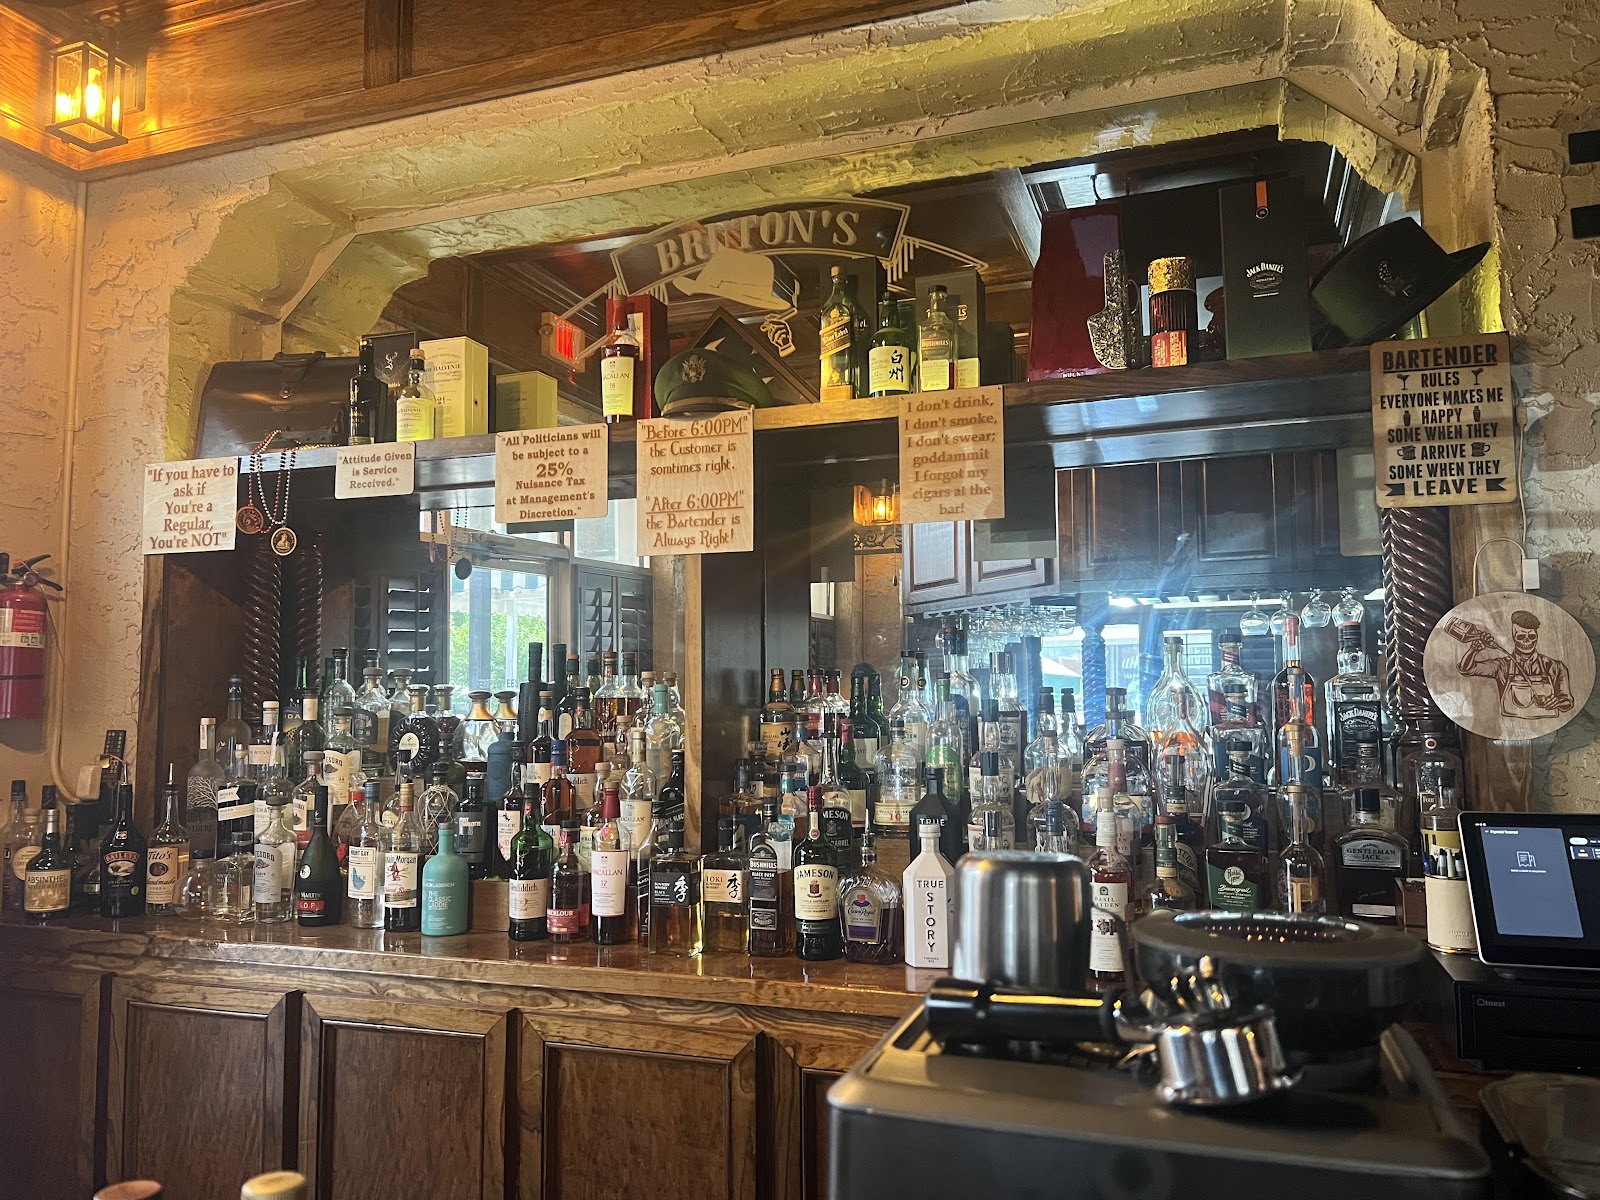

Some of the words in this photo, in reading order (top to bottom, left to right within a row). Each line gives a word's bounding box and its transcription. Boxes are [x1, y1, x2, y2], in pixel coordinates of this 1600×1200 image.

[1246, 265, 1261, 277] JACK
[1261, 262, 1284, 273] DANIEL'S
[1383, 343, 1498, 370] BARTENDER
[1421, 371, 1460, 388] RULES
[907, 402, 912, 413] I
[916, 399, 950, 412] don't
[953, 394, 994, 410] drink,
[1380, 392, 1440, 410] EVERYONE
[1442, 388, 1483, 406] MAKES
[1487, 387, 1504, 403] ME
[905, 420, 910, 431] I
[913, 416, 947, 430] don't
[950, 412, 998, 427] smoke,
[1421, 408, 1462, 425] HAPPY
[642, 424, 686, 440] "Before
[691, 415, 748, 437] 6:00PM"
[1387, 427, 1421, 443] SOME
[1425, 424, 1463, 441] WHEN
[1466, 422, 1498, 438] THEY
[502, 436, 519, 446] "All
[523, 432, 578, 444] Politicians
[582, 429, 601, 439] will
[907, 436, 913, 448] I
[916, 434, 950, 447] don't
[953, 432, 996, 443] swear;
[512, 451, 524, 460] be
[527, 448, 565, 460] subject
[569, 447, 579, 456] to
[583, 447, 589, 455] a
[650, 443, 666, 457] the
[670, 440, 722, 455] Customer
[727, 441, 736, 451] is
[1421, 443, 1466, 460] ARRIVE
[339, 453, 381, 465] "Attitude
[384, 452, 412, 461] Given
[651, 462, 701, 475] somtimes
[705, 456, 735, 475] right.
[913, 449, 990, 468] goddammit
[148, 467, 163, 482] "If
[166, 470, 188, 486] you
[192, 466, 219, 479] have
[223, 465, 234, 476] to
[352, 468, 360, 476] is
[363, 465, 398, 476] Service
[536, 461, 573, 478] 25%
[915, 471, 921, 482] I
[923, 468, 965, 484] forgot
[967, 468, 989, 481] my
[1389, 464, 1423, 480] SOME
[1426, 462, 1464, 478] WHEN
[1468, 460, 1501, 476] THEY
[173, 483, 193, 497] ask
[197, 482, 206, 495] if
[350, 477, 399, 489] Received."
[515, 479, 563, 490] Nuisance
[566, 477, 586, 486] Tax
[1413, 478, 1478, 496] LEAVE
[506, 497, 516, 505] at
[520, 491, 595, 505] Management's
[912, 488, 952, 502] cigars
[954, 486, 965, 496] at
[970, 483, 991, 495] the
[165, 500, 203, 515] You're
[206, 502, 213, 512] a
[646, 496, 682, 512] "After
[687, 490, 744, 509] 6:00PM"
[940, 503, 964, 515] bar!
[520, 507, 581, 519] Discretion."
[646, 515, 662, 530] the
[667, 511, 726, 529] Bartender
[731, 513, 740, 525] is
[164, 516, 214, 535] Regular,
[150, 535, 188, 549] You're
[191, 532, 227, 547] NOT"
[653, 532, 696, 548] Always
[700, 528, 734, 548] Right!
[1339, 710, 1354, 721] JACK
[1353, 708, 1378, 721] DANIEL'S
[823, 810, 850, 821] MESON
[919, 818, 946, 827] TRUE
[105, 852, 138, 862] BAILEYS
[148, 850, 173, 860] Tito's
[396, 855, 417, 865] Morgan
[750, 861, 777, 869] BUSHMILLS
[28, 875, 64, 884] ABSINTHE
[796, 868, 835, 880] JAMESON
[917, 880, 944, 889] TRUE
[847, 907, 861, 915] Crown
[860, 907, 877, 916] Royal
[926, 892, 936, 952] STORY
